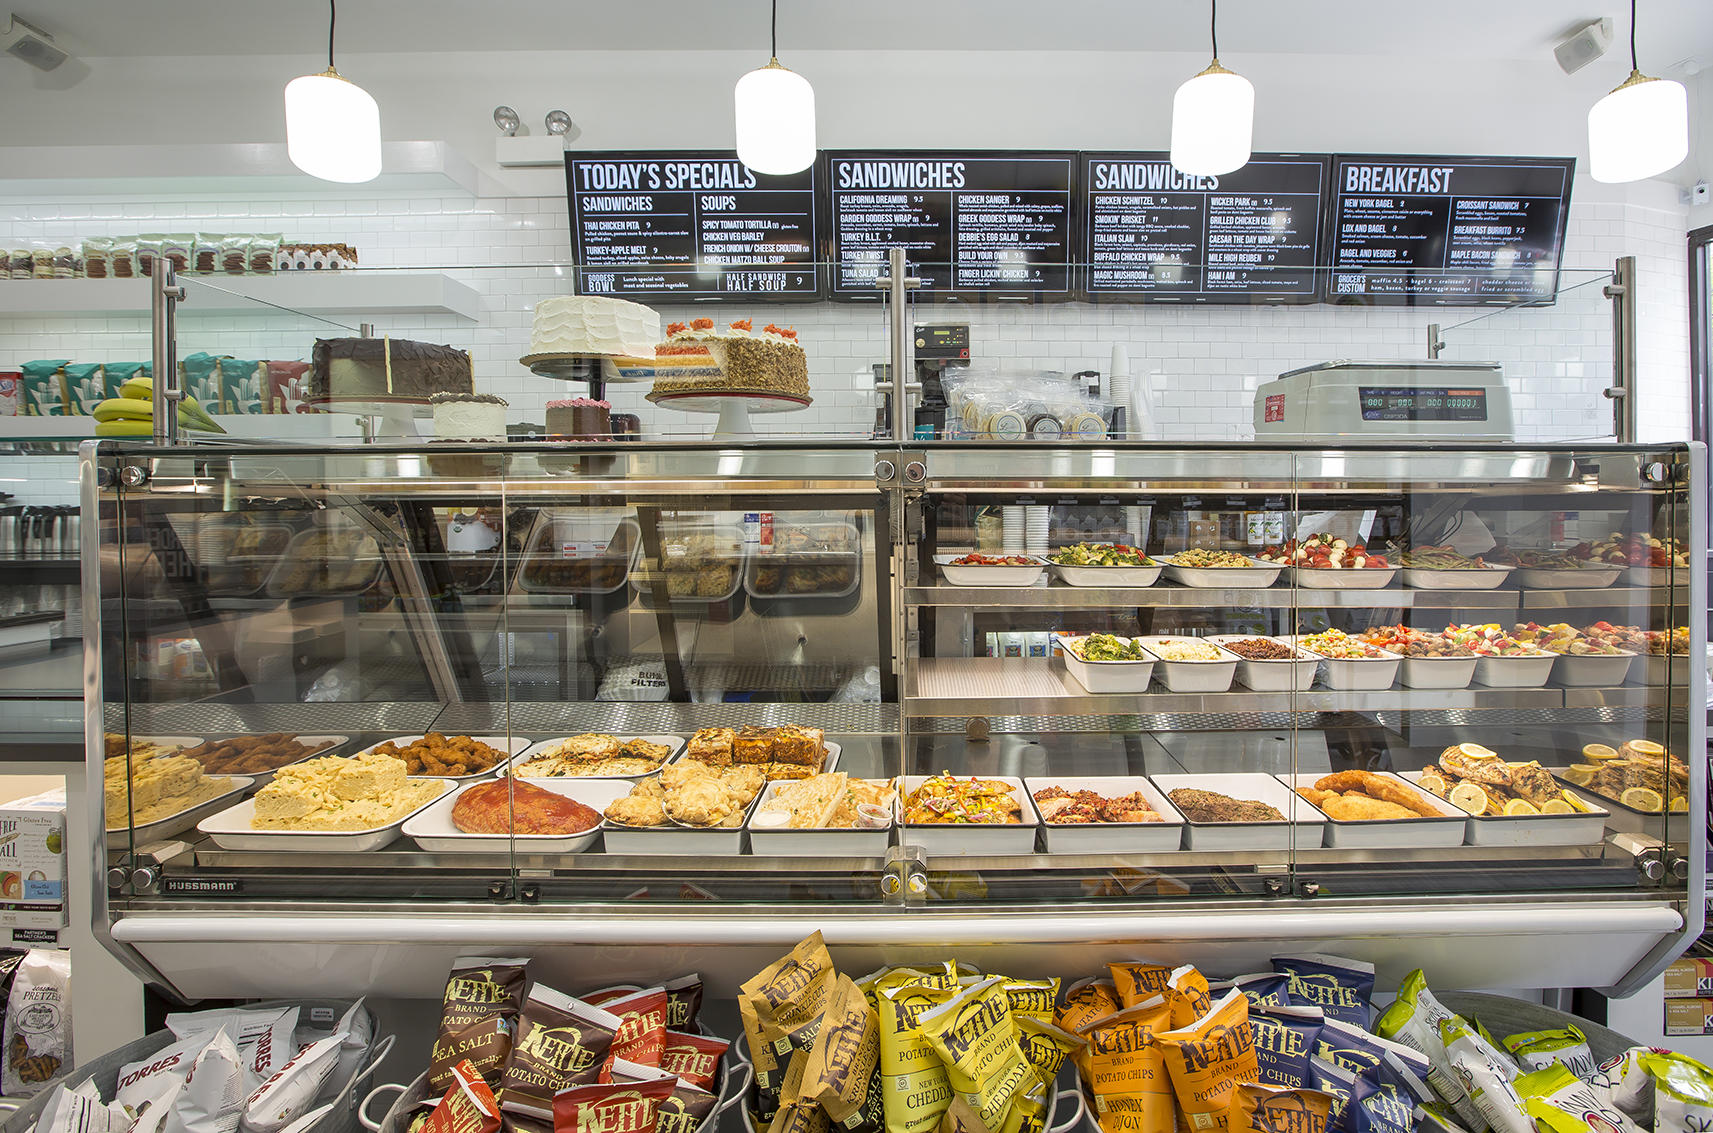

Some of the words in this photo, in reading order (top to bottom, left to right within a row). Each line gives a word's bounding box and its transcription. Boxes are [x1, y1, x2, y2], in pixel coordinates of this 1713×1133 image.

[580, 163, 660, 189] TODAY'S
[666, 163, 757, 189] SPECIALS
[839, 162, 966, 188] SANDWICHES
[1096, 164, 1219, 190] SANDWICHES
[1346, 166, 1454, 193] BREAKFAST
[583, 196, 652, 211] SANDWICHES
[702, 196, 736, 211] SOUPS
[840, 195, 875, 204] CALIFORNIA
[876, 195, 908, 204] DREAMING
[958, 195, 984, 204] CHICKEN
[985, 195, 1009, 204] SANGER
[1095, 196, 1120, 205] CHICKEN
[1122, 196, 1154, 205] SCHNITZEL
[1211, 198, 1234, 206] WICKER
[1234, 198, 1250, 206] PARK
[1344, 199, 1358, 208] NEW
[1359, 199, 1375, 208] YORK
[1375, 199, 1394, 208] BAGEL
[1457, 201, 1488, 209] CROISSANT
[1489, 201, 1520, 210] SANDWICH
[840, 214, 864, 222] GARDEN
[866, 214, 893, 222] GODDESS
[894, 214, 912, 222] WRAP
[959, 214, 978, 223] GREEK
[979, 214, 1006, 223] GODDESS
[1007, 214, 1025, 223] WRAP
[1121, 215, 1146, 224] BRISKET
[1235, 217, 1260, 225] CHICKEN
[1261, 217, 1276, 225] CLUB
[584, 222, 598, 230] THAI
[599, 222, 625, 230] CHICKEN
[626, 222, 640, 230] PITA
[702, 220, 720, 229] SPICY
[720, 220, 744, 229] TOMATO
[745, 220, 772, 229] TORTILLA
[1342, 224, 1354, 232] LOX
[1354, 224, 1367, 232] AND
[1368, 224, 1386, 233] BAGEL
[1454, 226, 1487, 234] BREAKFAST
[1487, 226, 1512, 235] BURRITO
[703, 233, 728, 241] CHICKEN
[741, 233, 764, 241] BARLEY
[841, 233, 864, 241] TURKEY
[959, 233, 985, 241] DEBBIE'S
[986, 233, 998, 241] EGG
[999, 233, 1018, 241] SALAD
[1095, 234, 1117, 243] ITALIAN
[1118, 234, 1135, 243] SLAM
[1209, 235, 1232, 244] CAESAR
[1233, 235, 1244, 244] THE
[1245, 235, 1256, 244] DAY
[1258, 236, 1275, 244] WRAP
[585, 246, 630, 254] TURKEY-APPLE
[631, 246, 646, 254] MELT
[704, 244, 726, 252] FRENCH
[727, 244, 744, 252] ONION
[754, 244, 775, 252] CHEESE
[776, 244, 802, 252] CROUTON
[841, 251, 865, 259] TURKEY
[866, 251, 884, 259] TWIST
[1239, 254, 1261, 262] REUBEN
[1340, 249, 1359, 258] BAGEL
[1359, 249, 1372, 258] AND
[1372, 249, 1396, 258] VEGGIES
[1451, 250, 1471, 259] MAPLE
[1472, 251, 1490, 259] BACON
[841, 269, 857, 277] TUNA
[858, 269, 878, 277] SALAD
[1094, 271, 1113, 279] MAGIC
[1114, 271, 1147, 279] MUSHROOM
[1208, 272, 1222, 280] HAM
[727, 280, 754, 290] HALF
[760, 280, 786, 290] SOUP
[796, 277, 802, 285] 9
[589, 281, 615, 292] BOWL
[1338, 283, 1365, 292] CUSTOM
[757, 959, 822, 1010] KETTLE
[1284, 967, 1362, 1008] KETTLE
[812, 985, 827, 1001] CUT
[938, 993, 1008, 1065] KETTLE
[459, 1032, 495, 1053] SALT
[515, 1021, 595, 1072] KETTLE
[613, 1040, 644, 1057] BRAND
[1178, 1021, 1254, 1074] KETTLE
[817, 1010, 868, 1095] KETTLE
[1112, 1057, 1134, 1066] BRAND
[118, 1052, 184, 1091] TORRES
[533, 1062, 563, 1080] BRAND
[1211, 1062, 1239, 1078] BRAND
[1096, 1071, 1126, 1083] POTATO
[1128, 1069, 1154, 1080] CHIPS
[1266, 1068, 1302, 1087] CHIPS
[919, 1080, 933, 1090] NEW
[980, 1061, 1028, 1121] CHEDDAR
[986, 1084, 997, 1098] NEW
[1193, 1078, 1233, 1102] POTATO
[1106, 1098, 1144, 1112] HONEY
